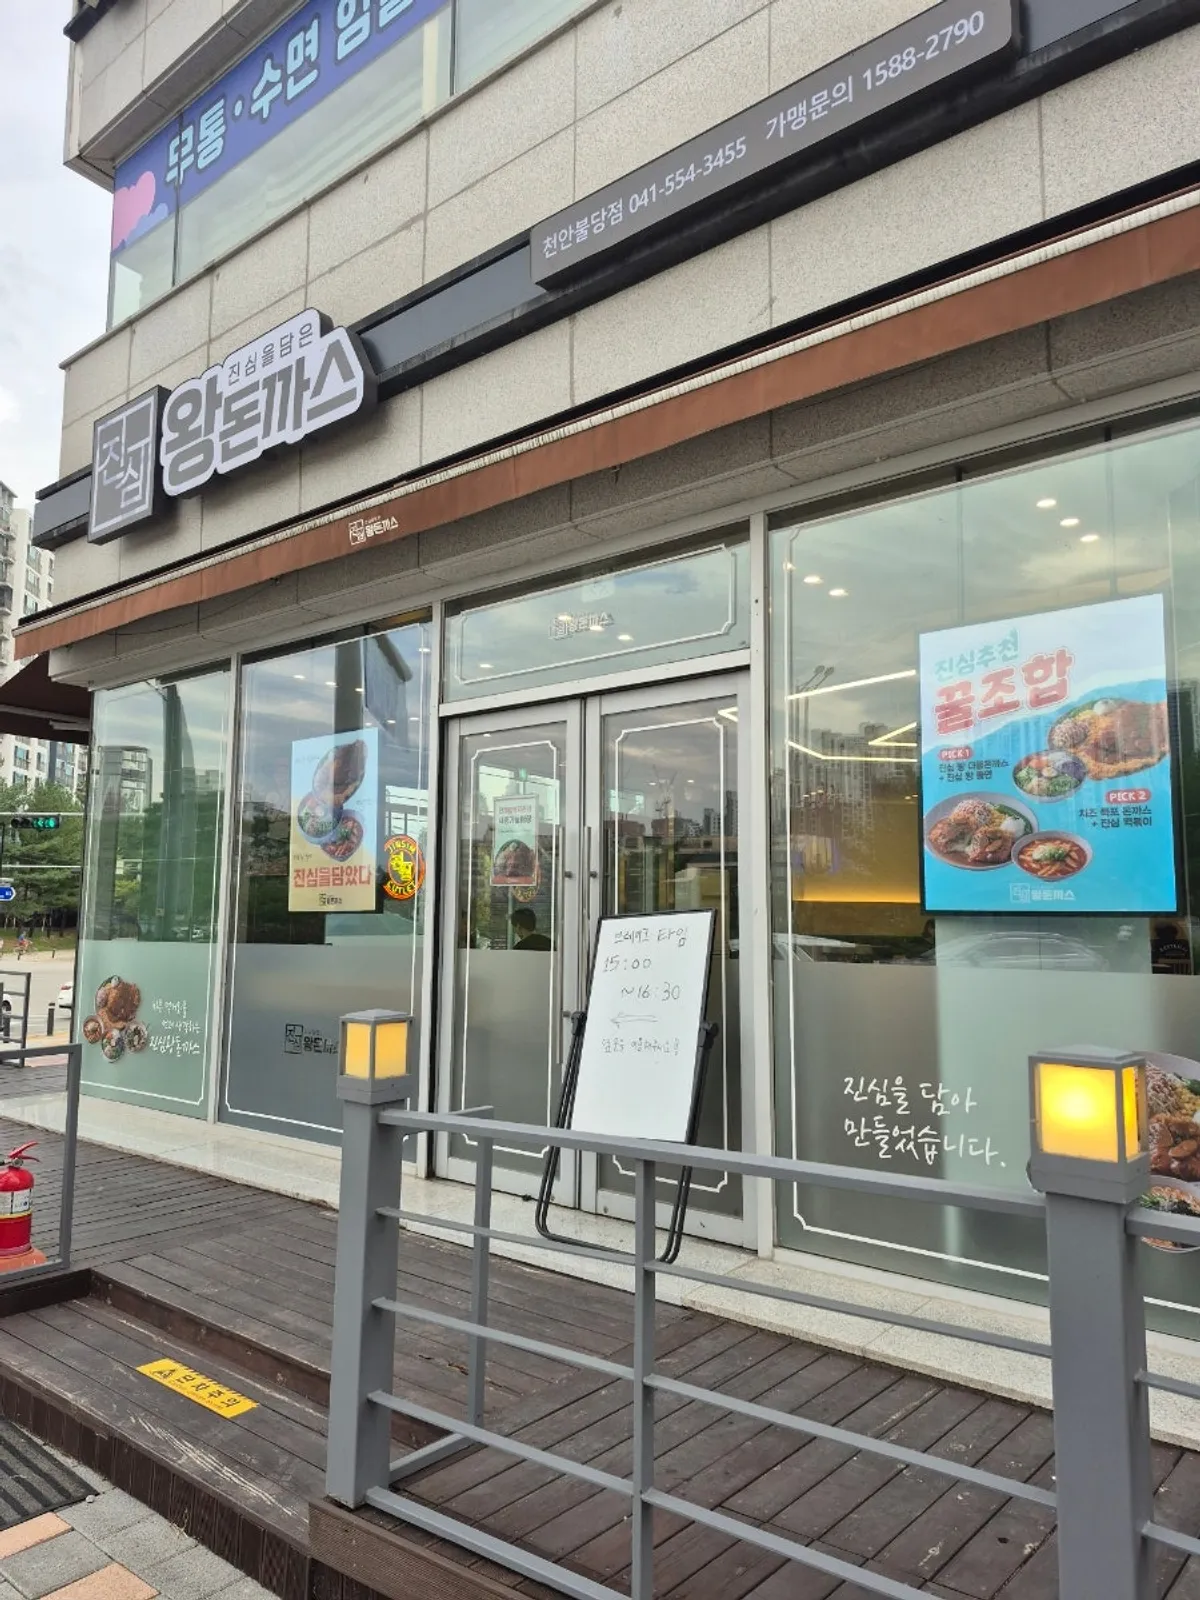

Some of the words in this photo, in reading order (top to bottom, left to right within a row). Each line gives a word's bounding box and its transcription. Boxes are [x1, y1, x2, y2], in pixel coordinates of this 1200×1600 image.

[542, 197, 623, 259] 천안불당점
[629, 135, 747, 214] 041-554-3455
[766, 75, 853, 140] 가맹문의
[862, 10, 984, 91] 1588-2790
[164, 338, 358, 488] 왕돈까스
[935, 628, 1020, 682] 진심추천
[935, 648, 1074, 736] 꿀조합
[941, 750, 964, 760] PICK
[965, 749, 971, 758] 1
[1079, 808, 1098, 818] 치즈
[1122, 805, 1152, 816] 돈까스
[1109, 791, 1136, 801] PICK
[1138, 790, 1147, 800] 2
[293, 864, 372, 889] 진심을담았다
[657, 926, 689, 948] 타임
[602, 954, 652, 973] 15:00
[844, 1075, 911, 1115] 진심을
[919, 1082, 978, 1116] 담아
[844, 1115, 1007, 1168] 만들었습니다.
